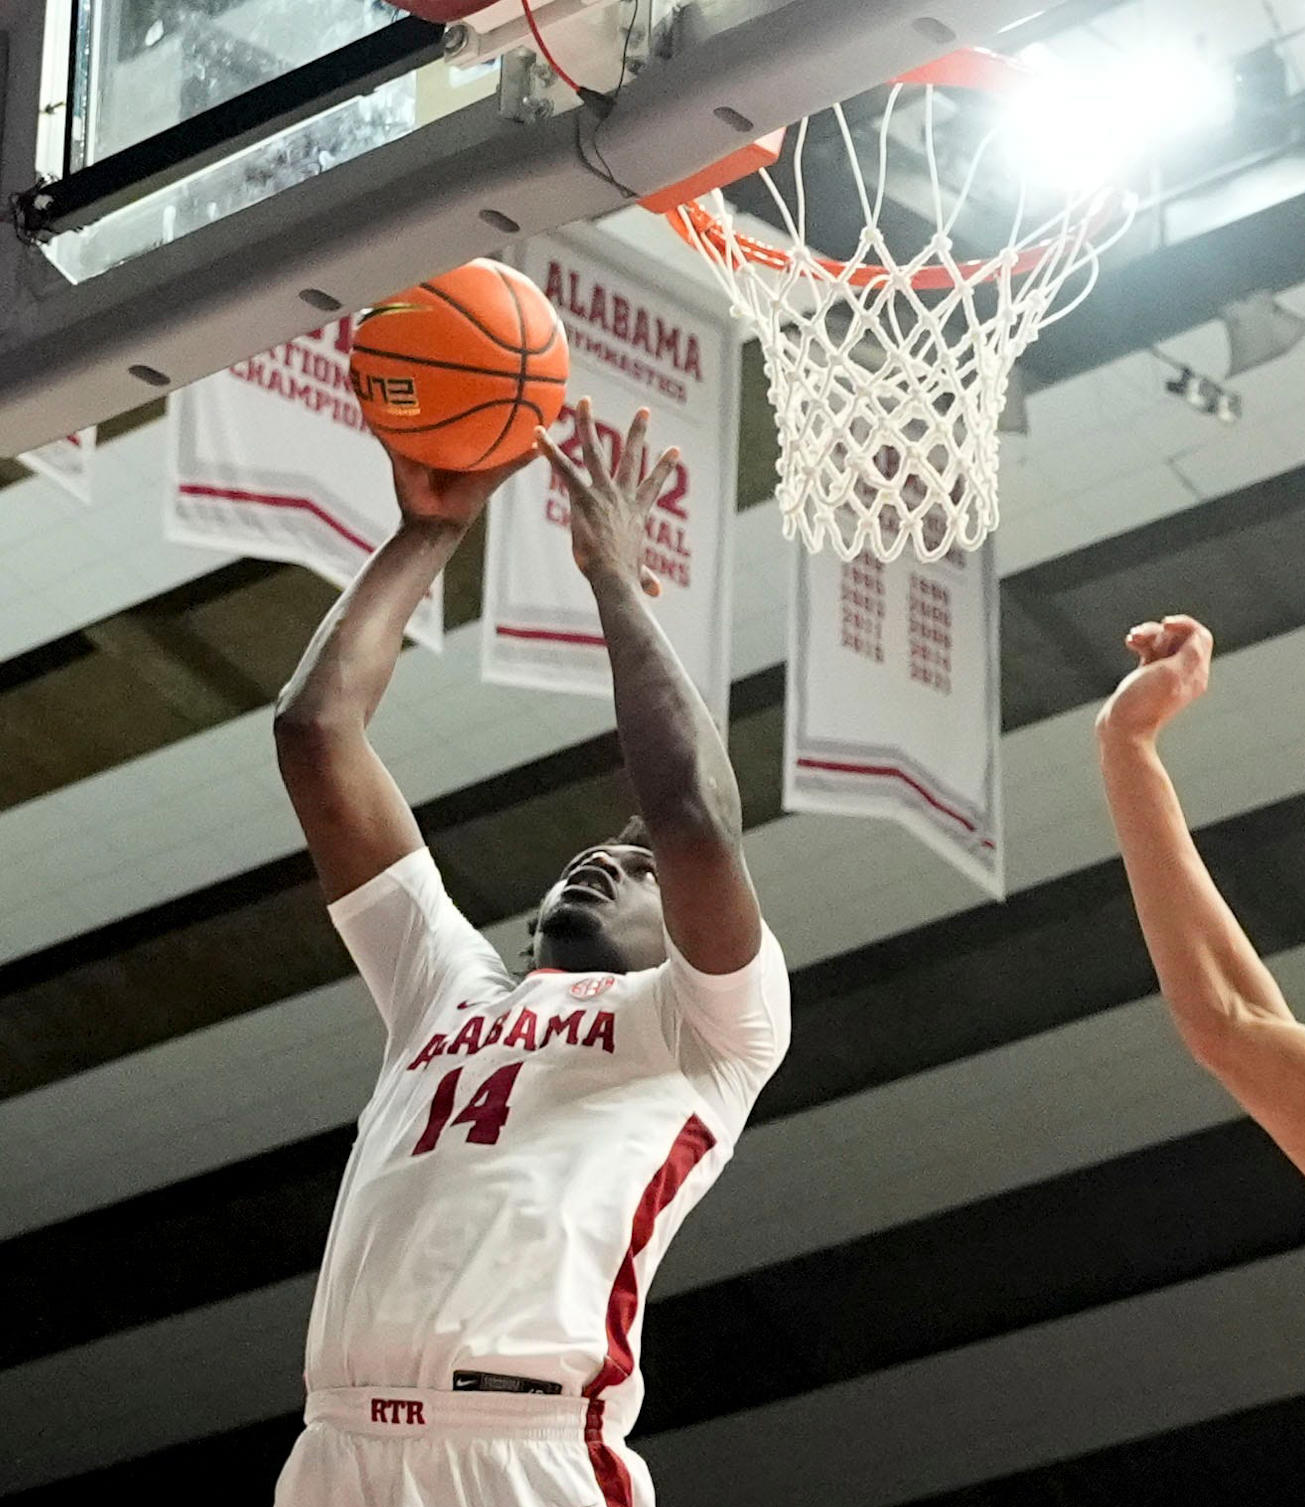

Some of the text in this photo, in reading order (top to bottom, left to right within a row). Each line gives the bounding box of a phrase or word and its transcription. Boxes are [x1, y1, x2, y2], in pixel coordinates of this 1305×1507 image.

[545, 261, 704, 383] ALABAMA
[411, 1060, 525, 1157] 14
[371, 1398, 426, 1425] RTR
